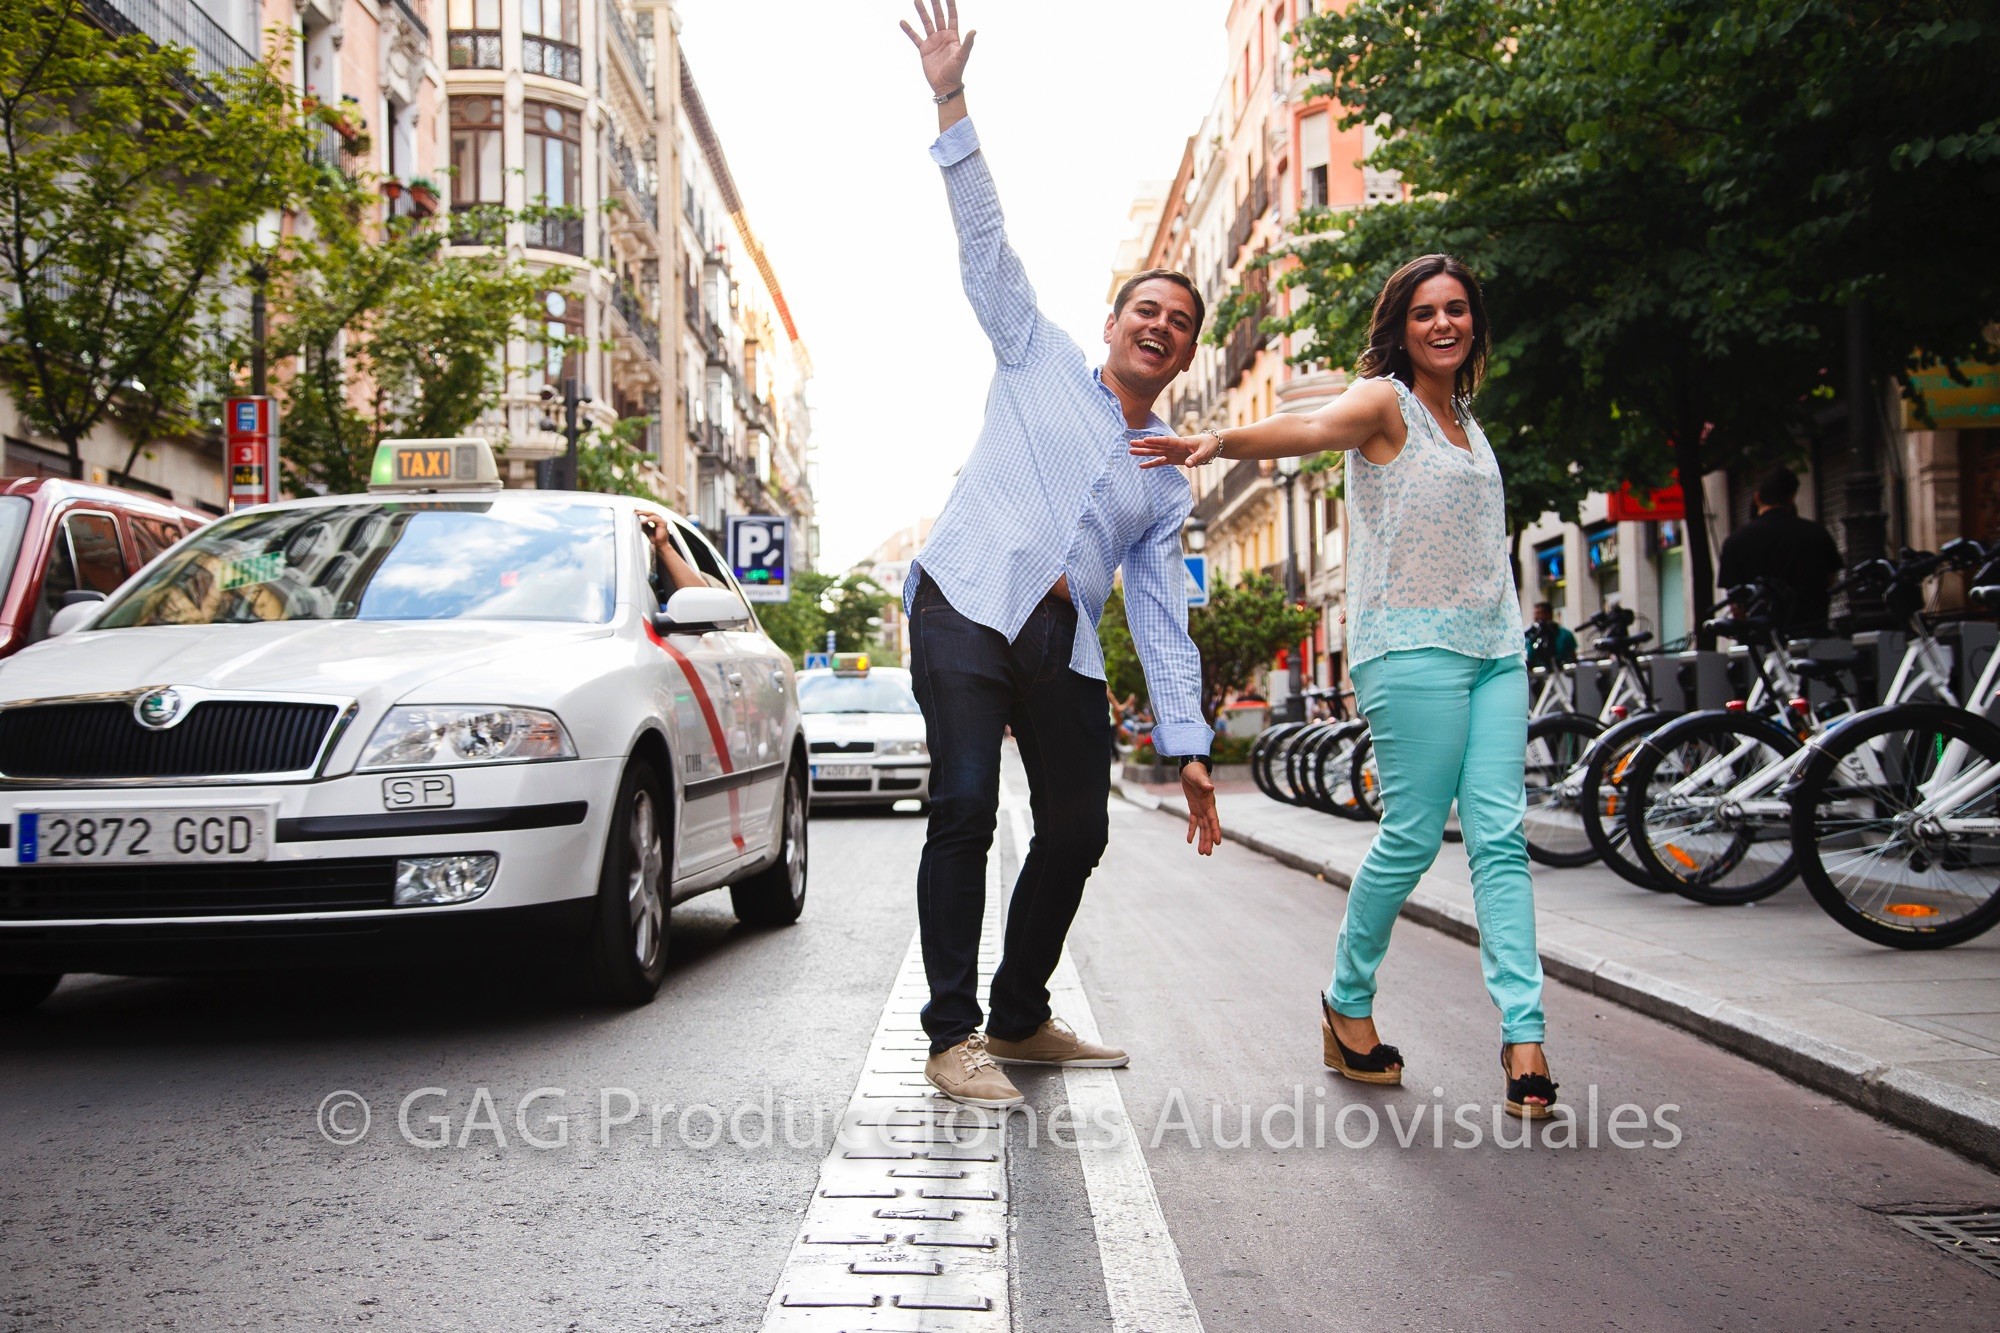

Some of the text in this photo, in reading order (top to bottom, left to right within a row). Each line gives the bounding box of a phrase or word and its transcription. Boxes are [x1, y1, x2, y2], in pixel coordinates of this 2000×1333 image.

[241, 447, 252, 462] 3
[399, 451, 450, 477] TAXI
[738, 526, 770, 568] P
[392, 780, 445, 805] SP
[49, 815, 252, 857] 2872 GGD
